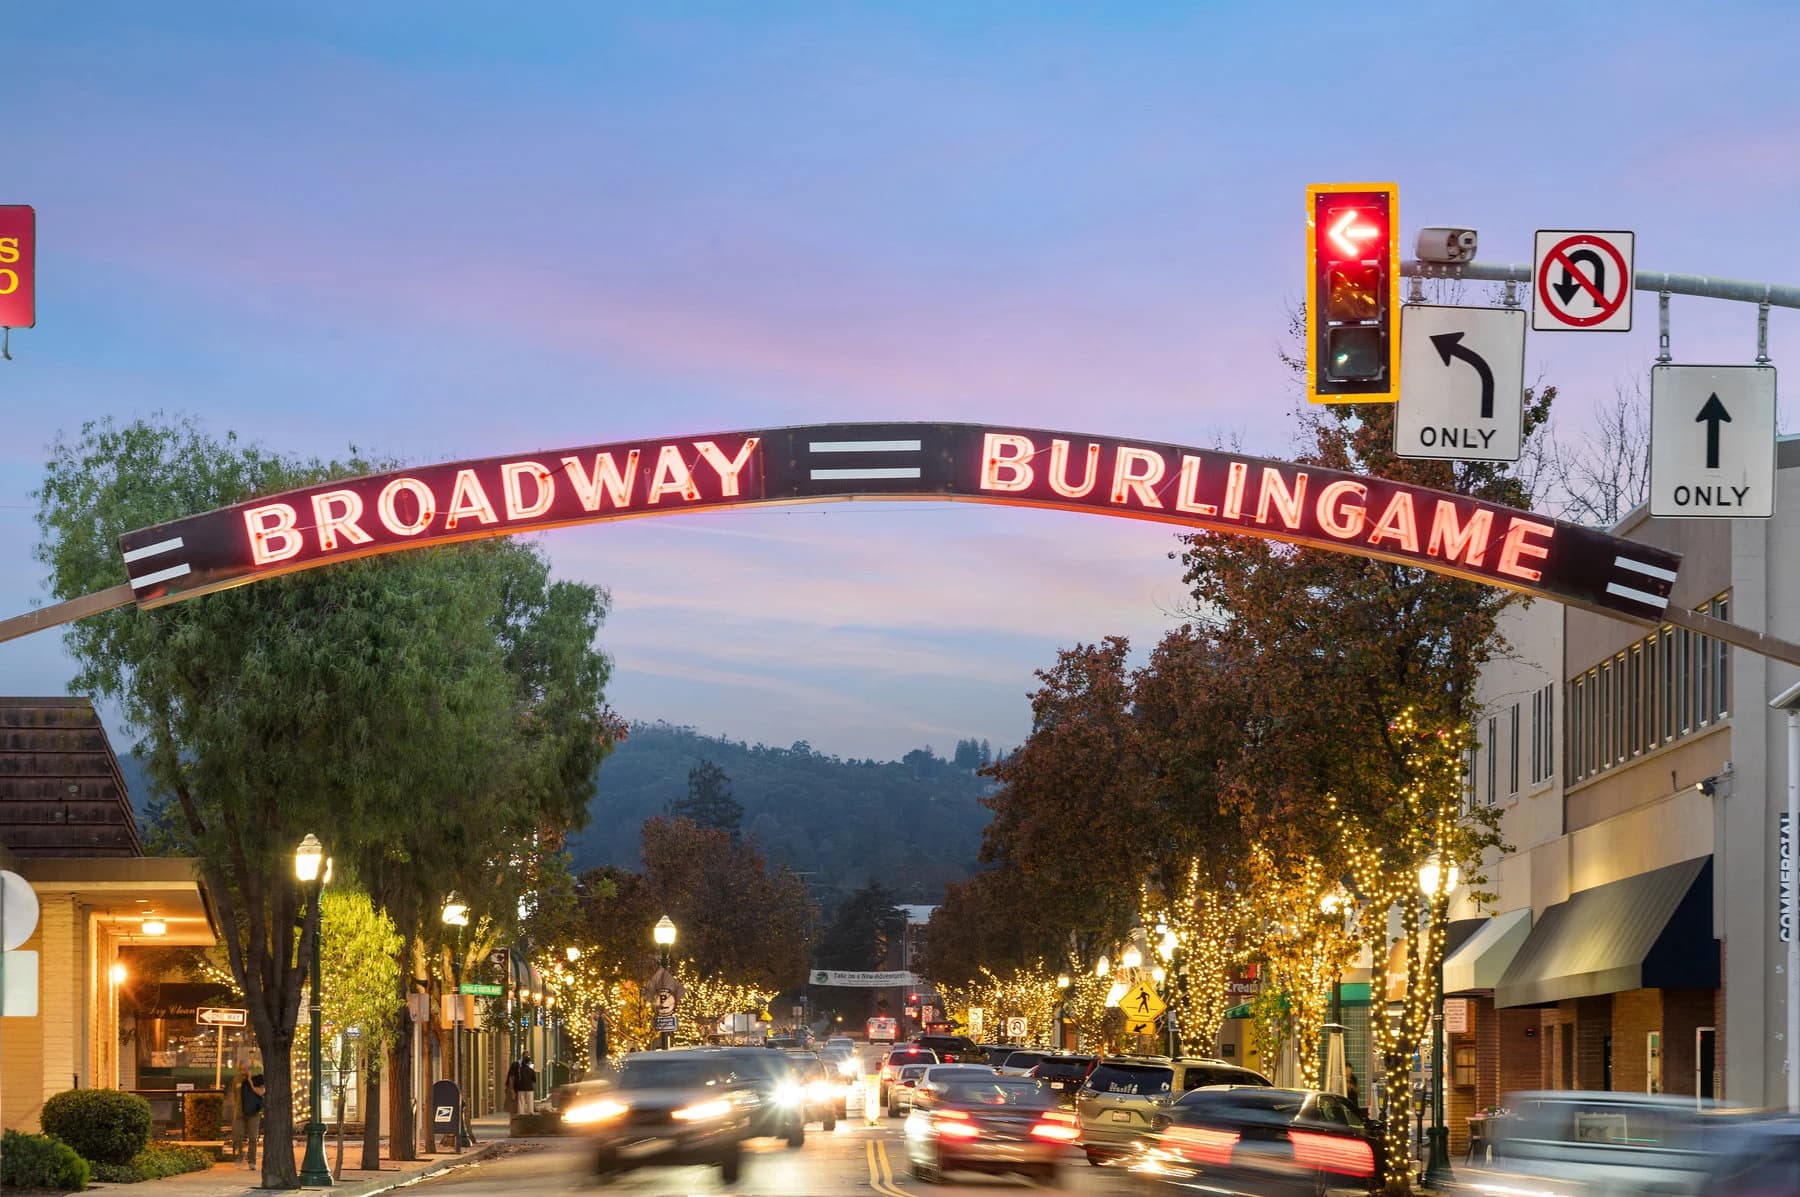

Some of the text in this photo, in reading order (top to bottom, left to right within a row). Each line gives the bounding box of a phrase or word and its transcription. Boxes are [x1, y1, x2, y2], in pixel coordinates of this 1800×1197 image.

[1419, 426, 1497, 450] ONLY
[243, 433, 1555, 582] BROADWAY BURLINGAME
[1673, 485, 1751, 507] ONLY
